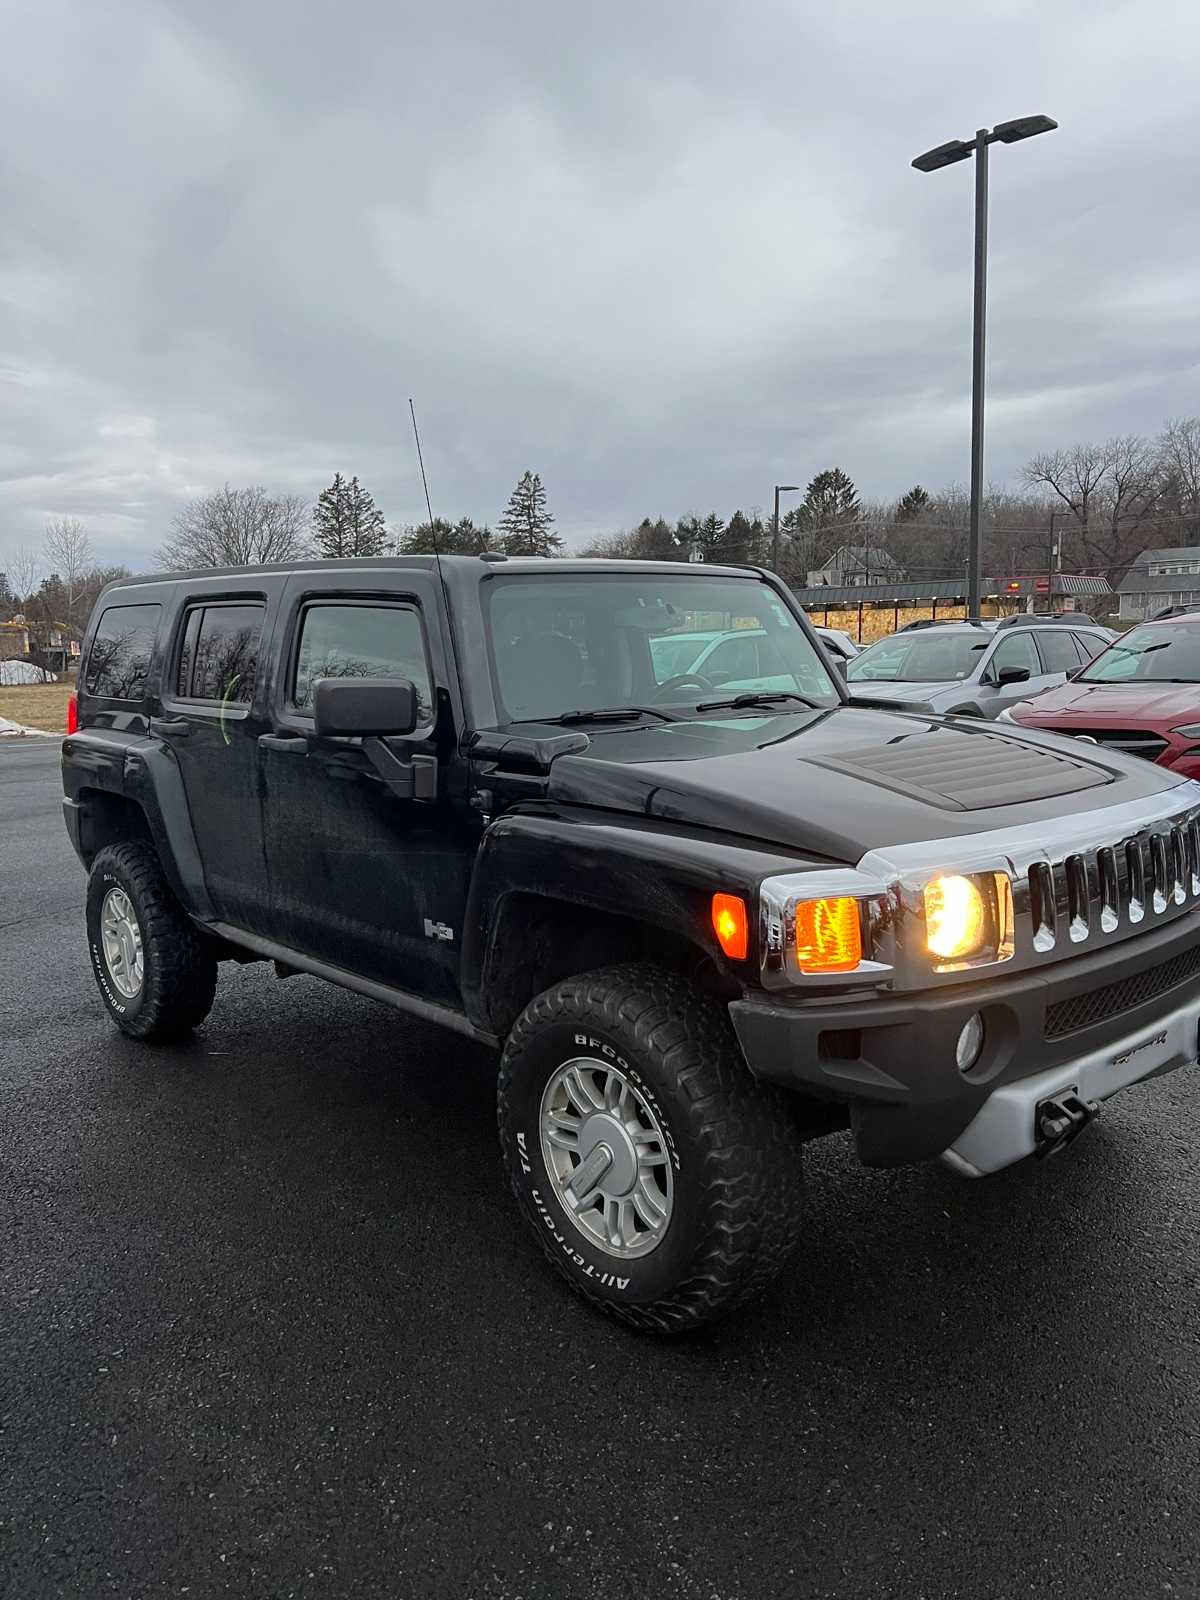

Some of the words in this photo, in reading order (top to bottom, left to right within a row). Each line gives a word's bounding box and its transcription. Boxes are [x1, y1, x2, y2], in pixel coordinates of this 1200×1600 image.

[574, 1034, 681, 1171] BFGoodrich
[516, 1132, 531, 1175] T/A
[532, 1189, 631, 1290] All-Terrain
